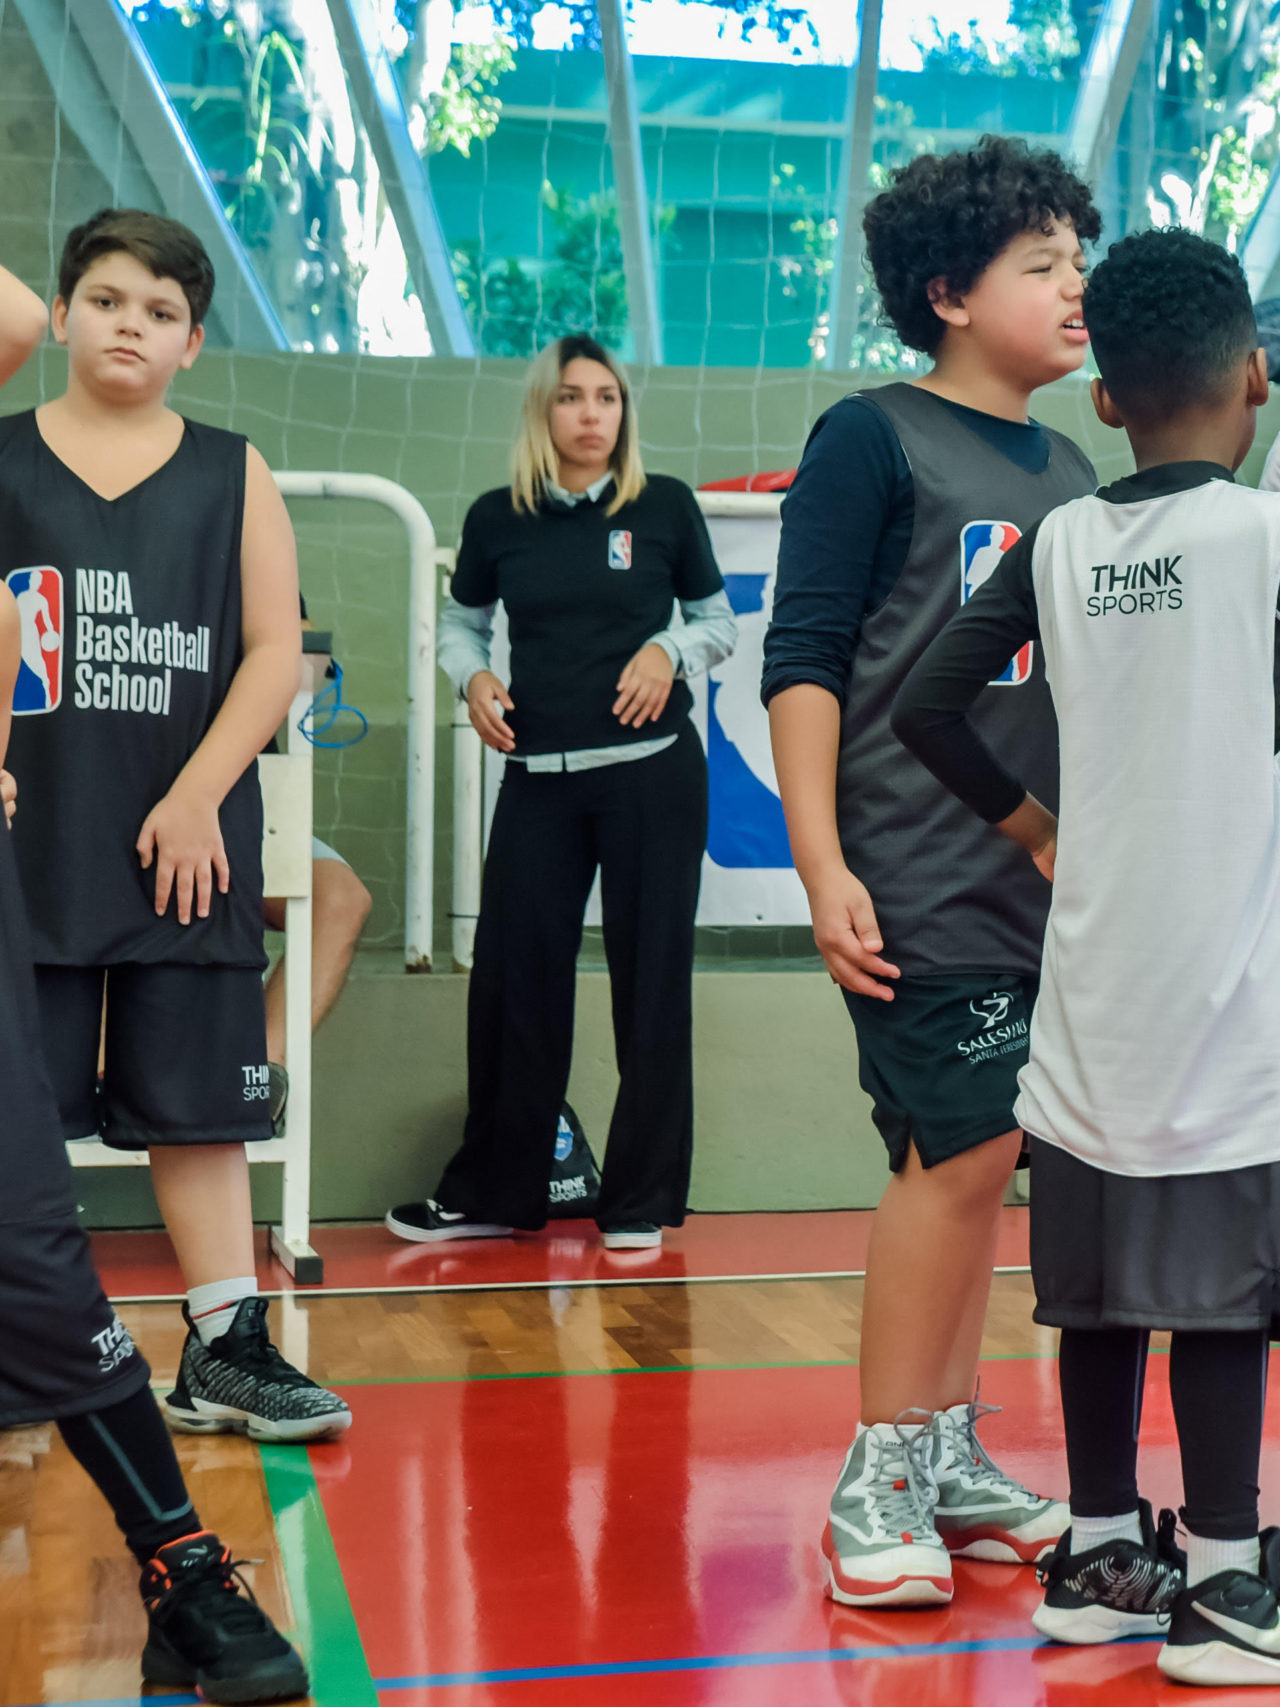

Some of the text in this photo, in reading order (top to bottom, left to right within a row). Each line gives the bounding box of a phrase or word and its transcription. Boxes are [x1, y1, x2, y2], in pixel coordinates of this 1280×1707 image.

[75, 567, 134, 615] NBA
[1091, 554, 1183, 593] THINK
[1086, 588, 1183, 617] SPORTS
[76, 615, 210, 673] Basketball
[74, 662, 172, 716] School
[969, 1048, 1000, 1065] SANTA
